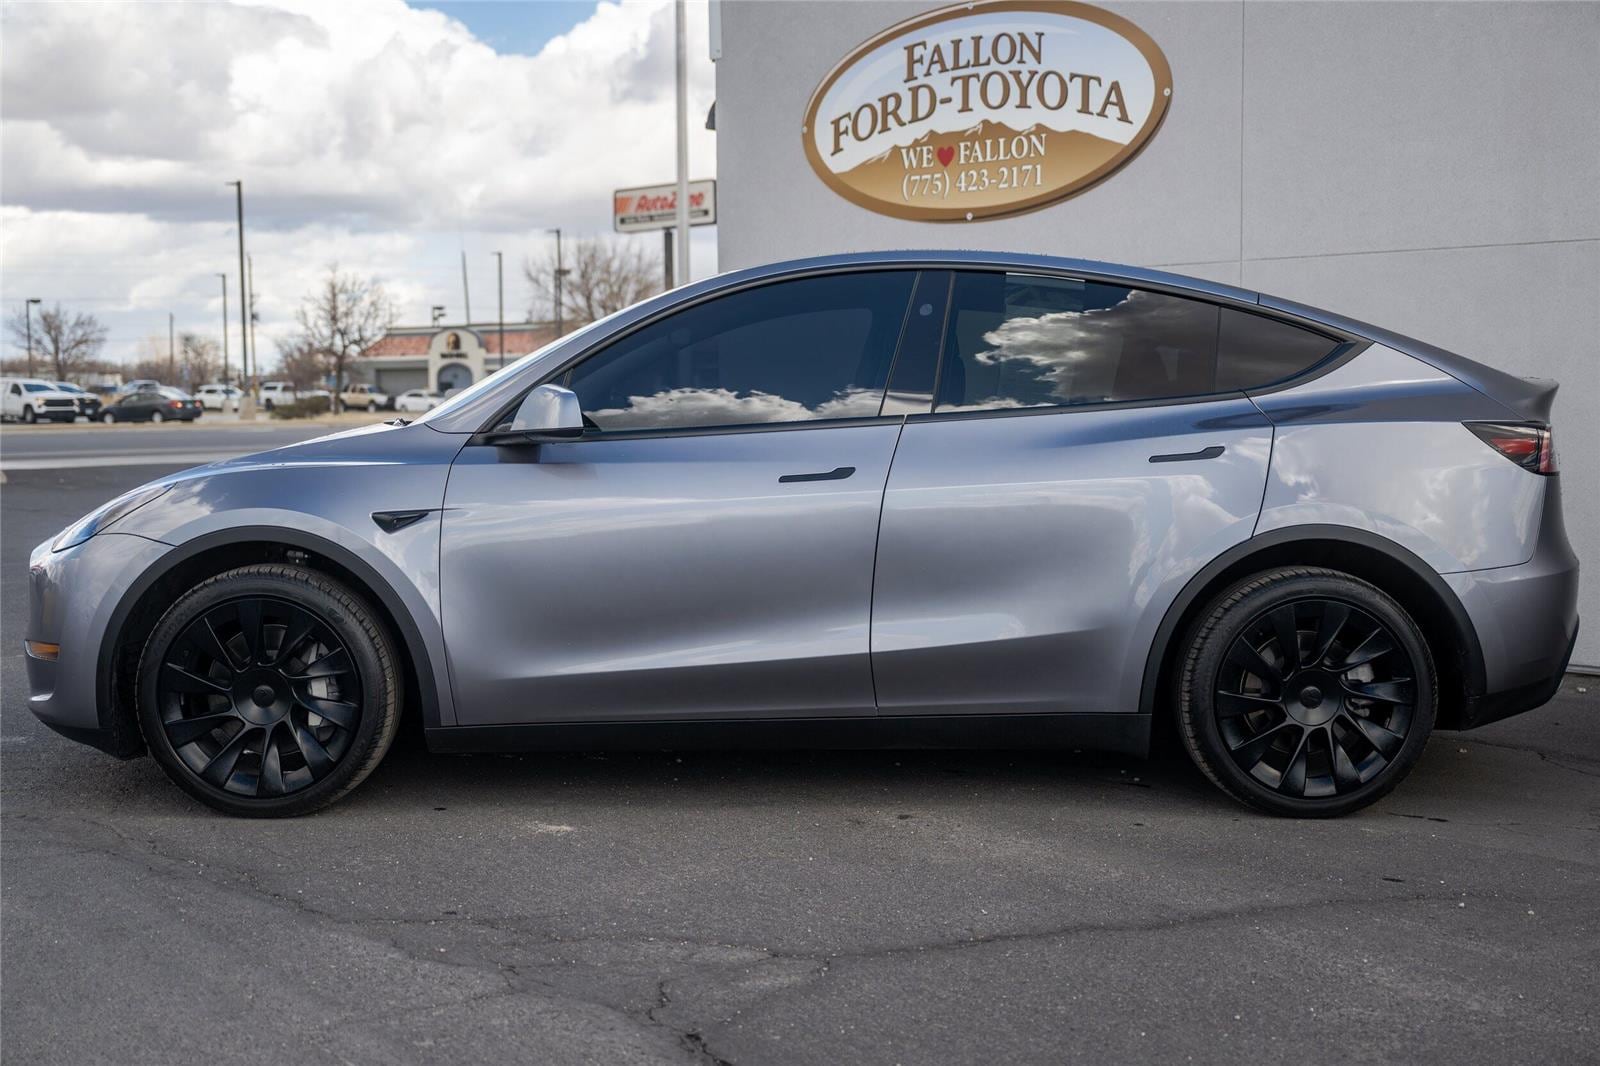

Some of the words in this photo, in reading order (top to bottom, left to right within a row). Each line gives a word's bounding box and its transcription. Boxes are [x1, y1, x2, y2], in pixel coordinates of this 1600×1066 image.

[903, 32, 1044, 82] FALLON
[830, 70, 1133, 156] FORD-TOYOTA
[900, 146, 934, 169] WE
[958, 133, 1046, 164] FALLON
[901, 173, 950, 200] (775)
[956, 164, 1044, 194] 423-2171
